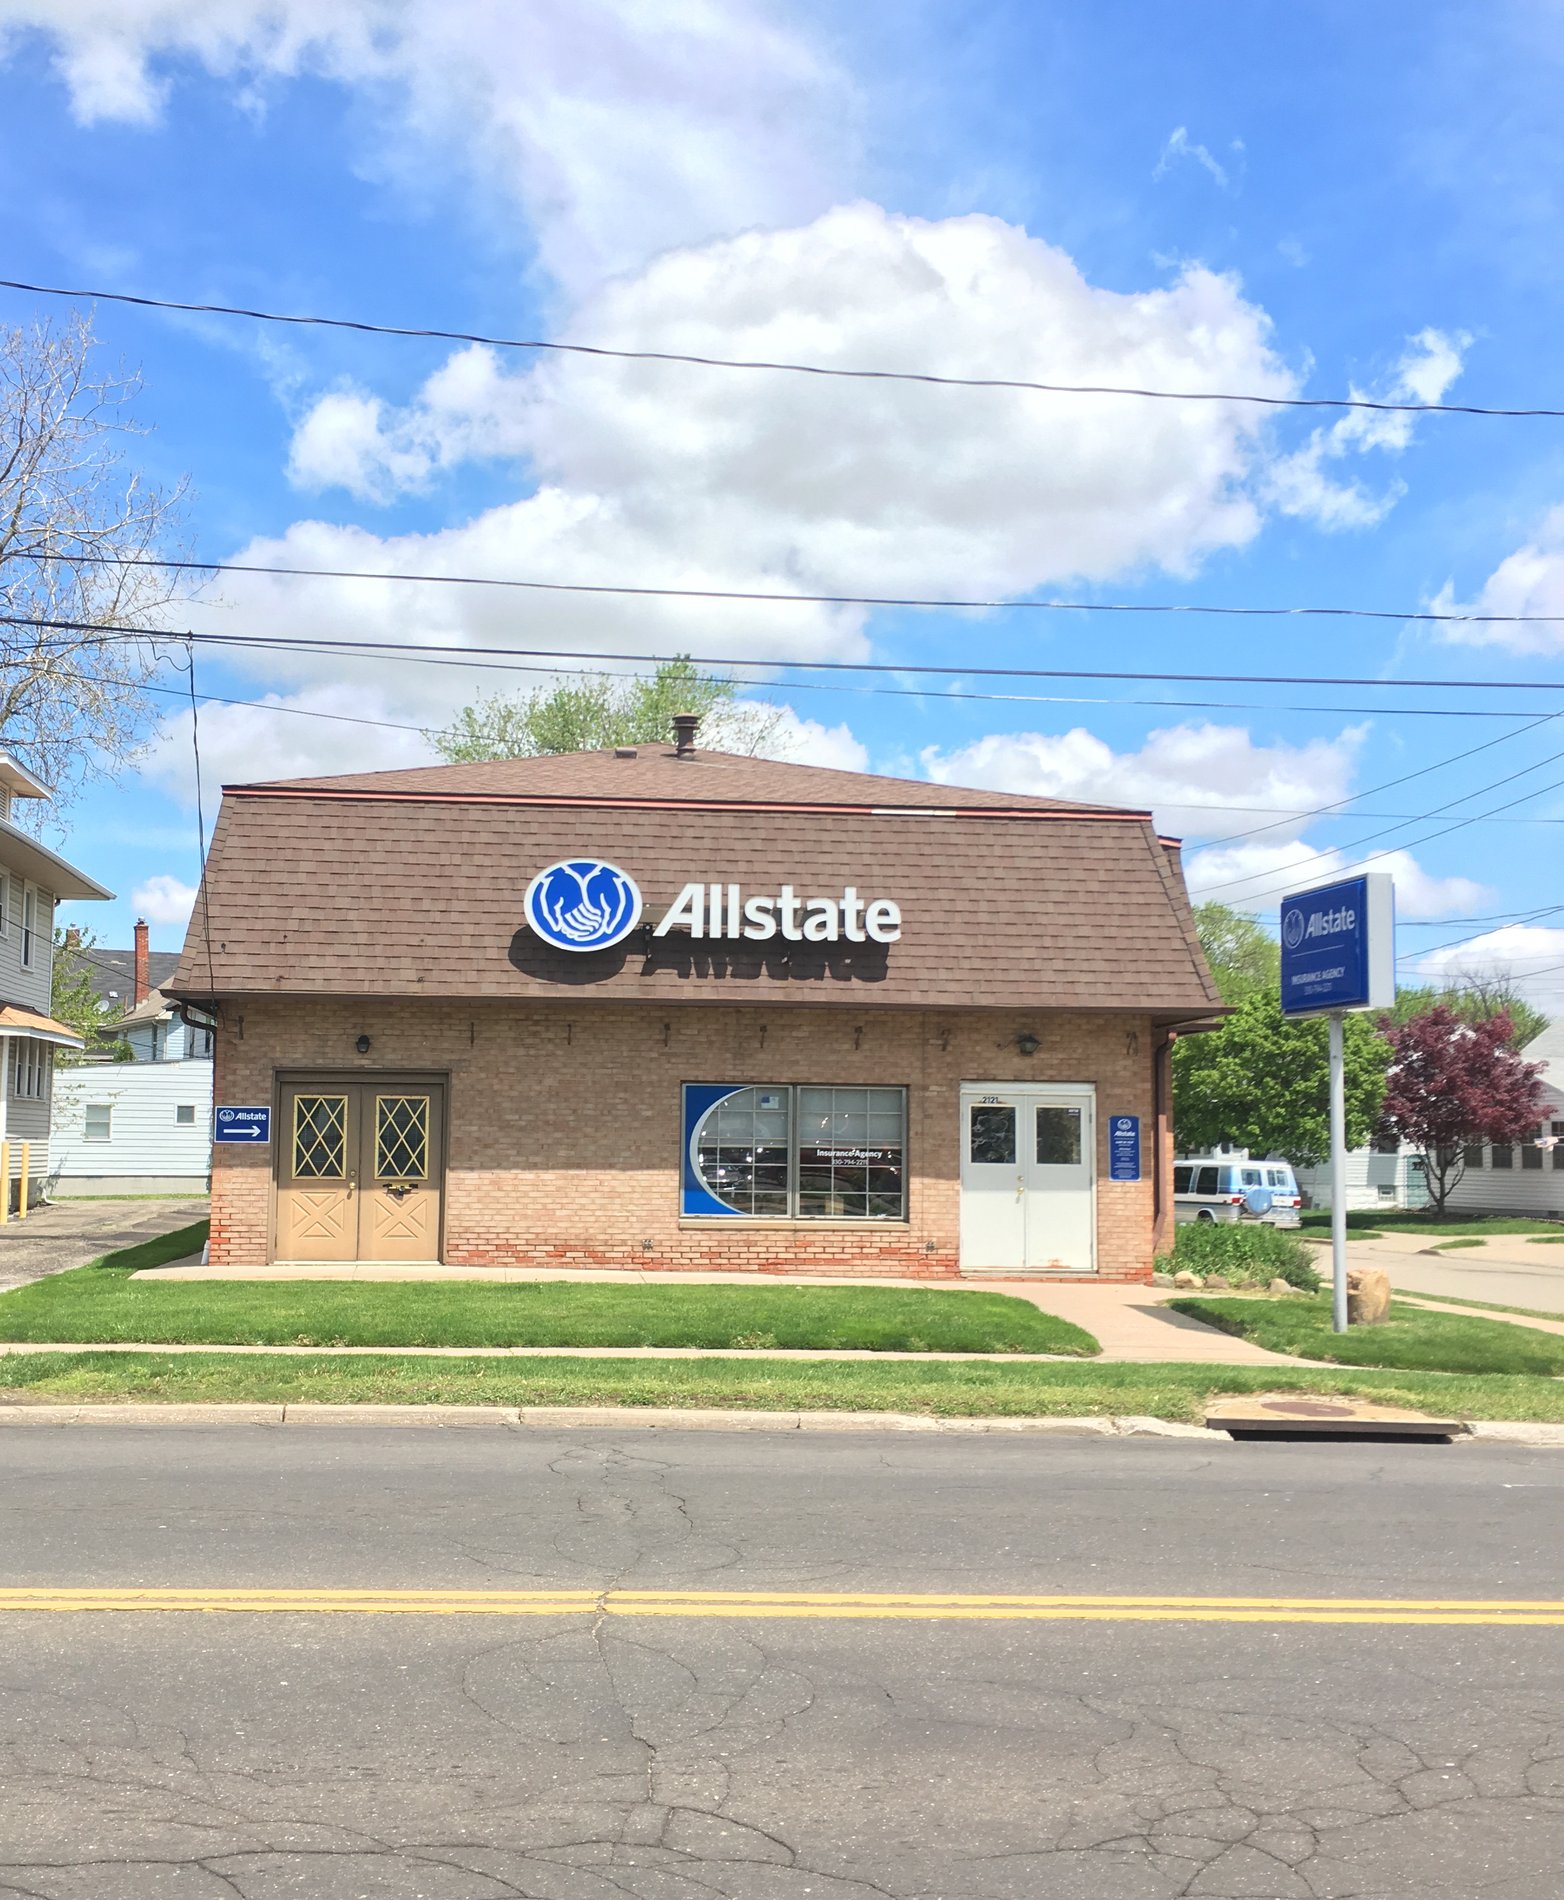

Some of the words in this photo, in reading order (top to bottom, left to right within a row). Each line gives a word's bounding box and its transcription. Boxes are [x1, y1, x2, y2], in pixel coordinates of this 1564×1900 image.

[652, 883, 902, 943] Allstate
[1305, 906, 1356, 939] Allstate
[1291, 970, 1322, 985] INSURANCE
[1322, 966, 1346, 980] AGENCY
[235, 1112, 267, 1120] Allstate
[816, 1149, 854, 1157] Insurance
[855, 1150, 882, 1159] Agency
